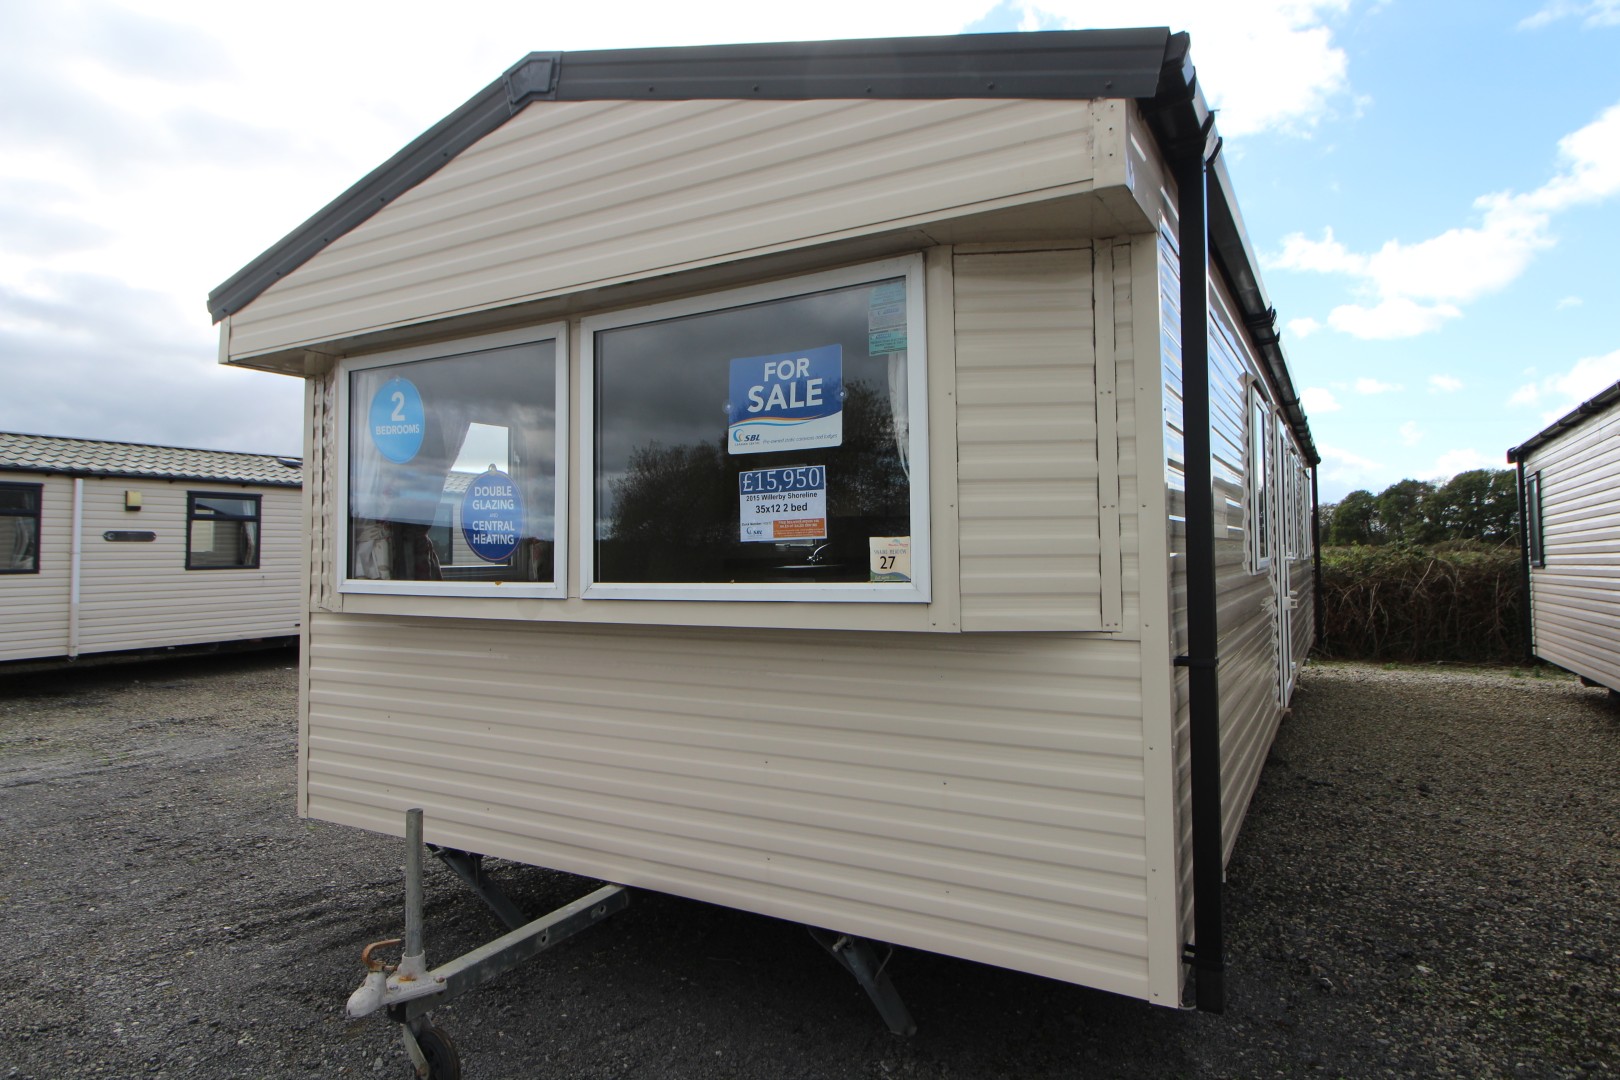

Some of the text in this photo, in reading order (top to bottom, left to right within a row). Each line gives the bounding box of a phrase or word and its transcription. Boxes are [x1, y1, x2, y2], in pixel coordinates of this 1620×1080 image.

[764, 358, 810, 382] FOR
[747, 378, 823, 413] SALE
[391, 391, 405, 422] 2
[375, 424, 420, 435] BEDROOMS
[742, 467, 820, 492] £15,950
[474, 486, 512, 497] DOUBLE
[761, 493, 786, 501] Willerby
[787, 491, 818, 499] Shoreline
[472, 499, 515, 510] GLAZING
[755, 502, 808, 513] 35x12 2 bed
[472, 520, 516, 531] CENTRAL
[473, 533, 515, 545] HEATING
[880, 555, 896, 569] 27
